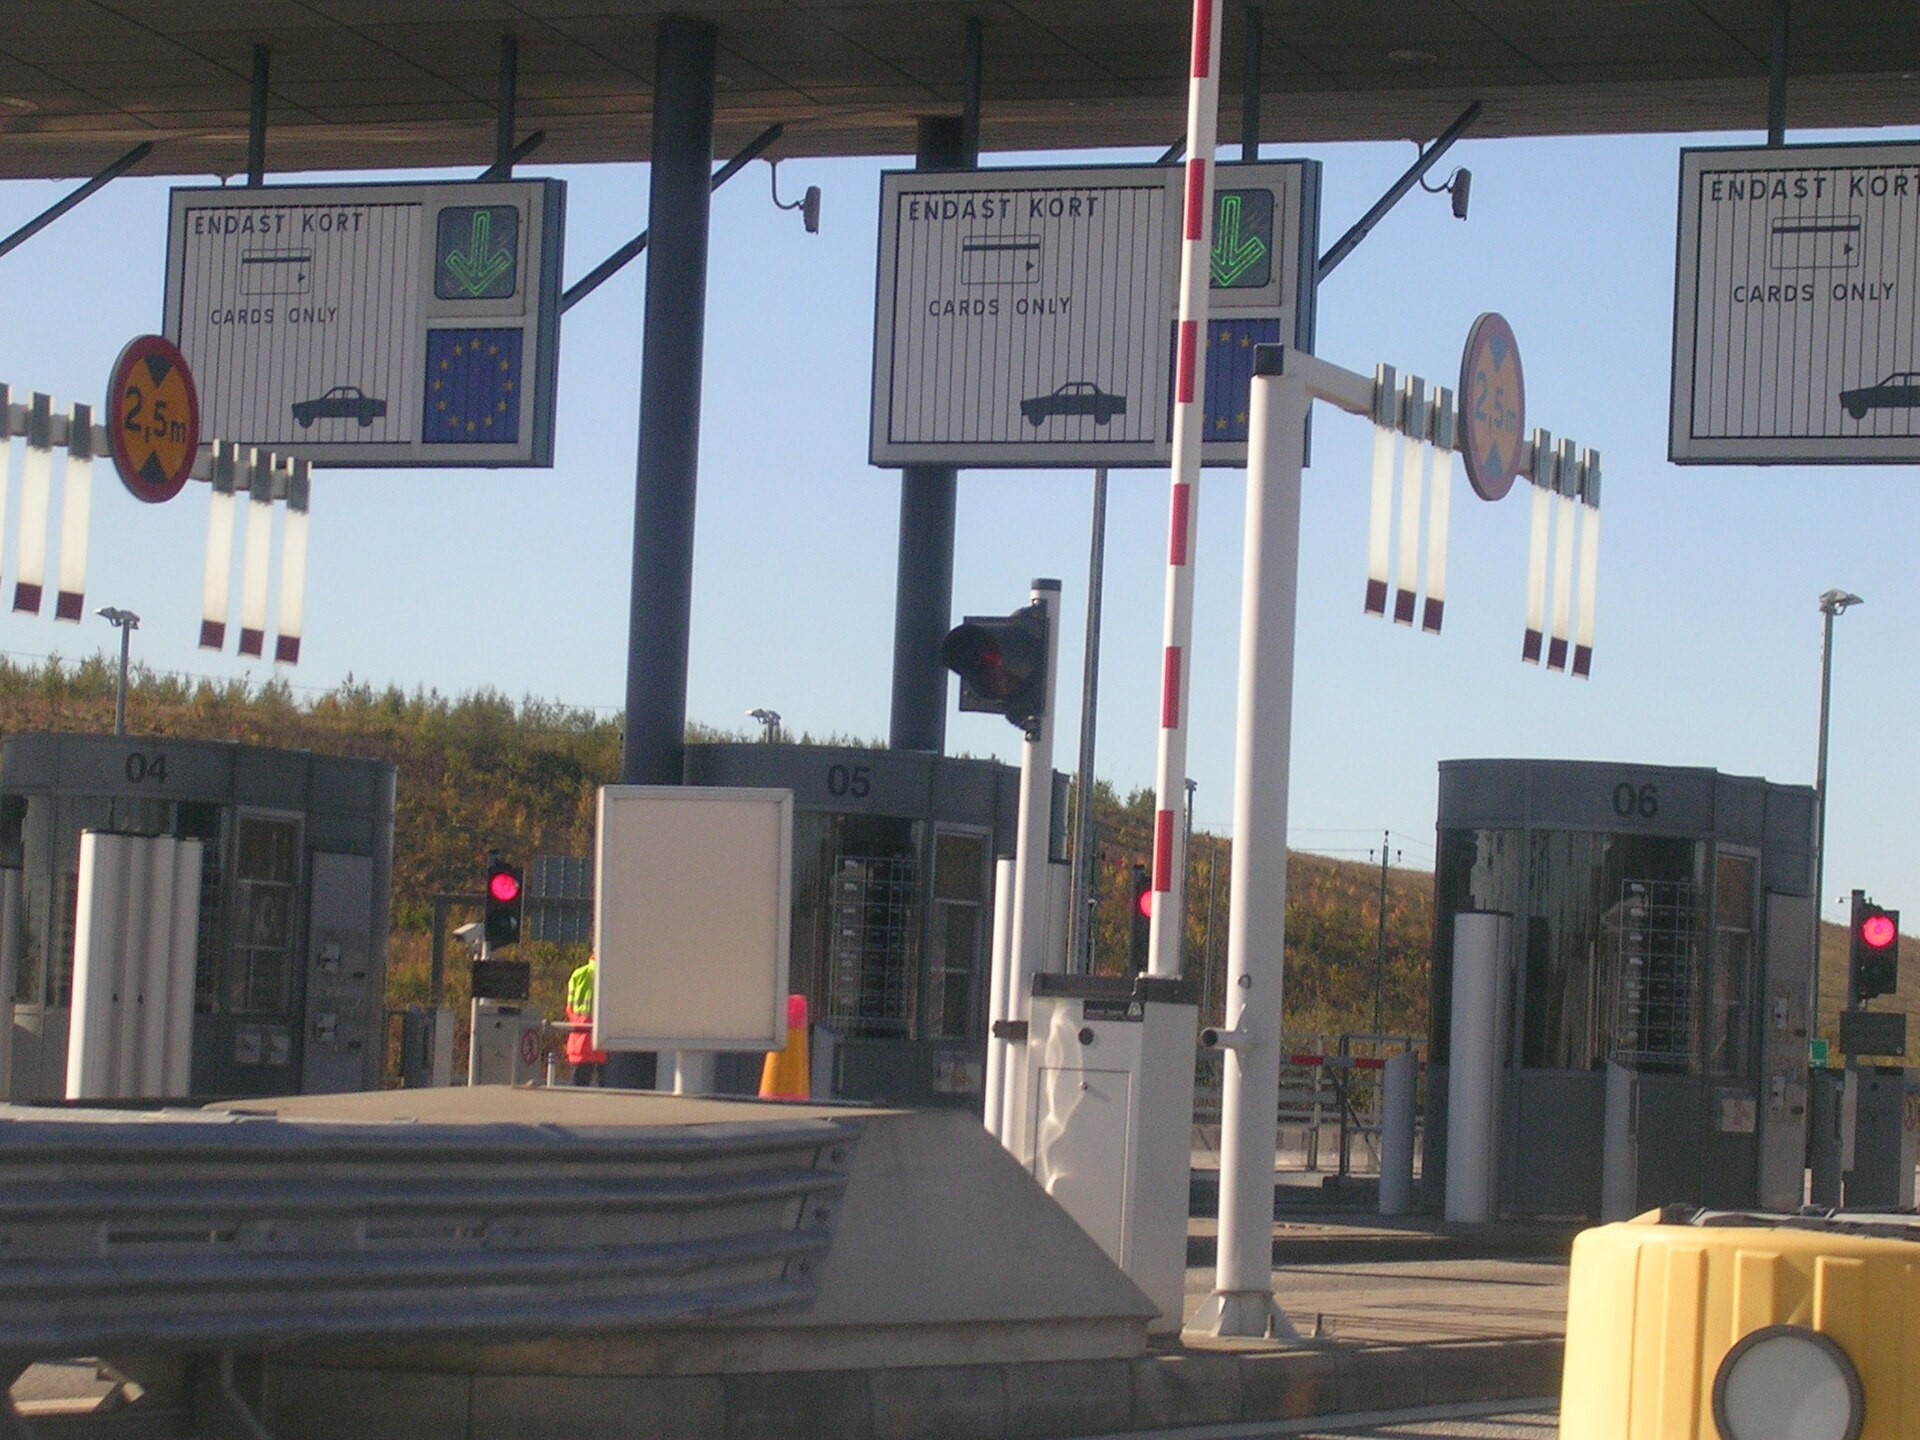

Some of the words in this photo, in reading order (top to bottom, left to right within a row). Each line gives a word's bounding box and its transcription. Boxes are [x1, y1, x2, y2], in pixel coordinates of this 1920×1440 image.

[1711, 177, 1827, 201] ENDAST
[909, 199, 1011, 220] ENDAST
[1030, 196, 1099, 218] KORT
[194, 214, 286, 234] ENDAST
[302, 212, 363, 233] KORT
[1733, 284, 1815, 302] CARDS
[1832, 282, 1895, 301] ONLY
[210, 308, 275, 325] CARDS
[288, 307, 337, 323] ONLY
[928, 299, 999, 317] CARDS
[1016, 297, 1071, 315] ONLY
[125, 752, 168, 785] 04
[827, 764, 871, 798] 05
[1612, 782, 1658, 818] 06
